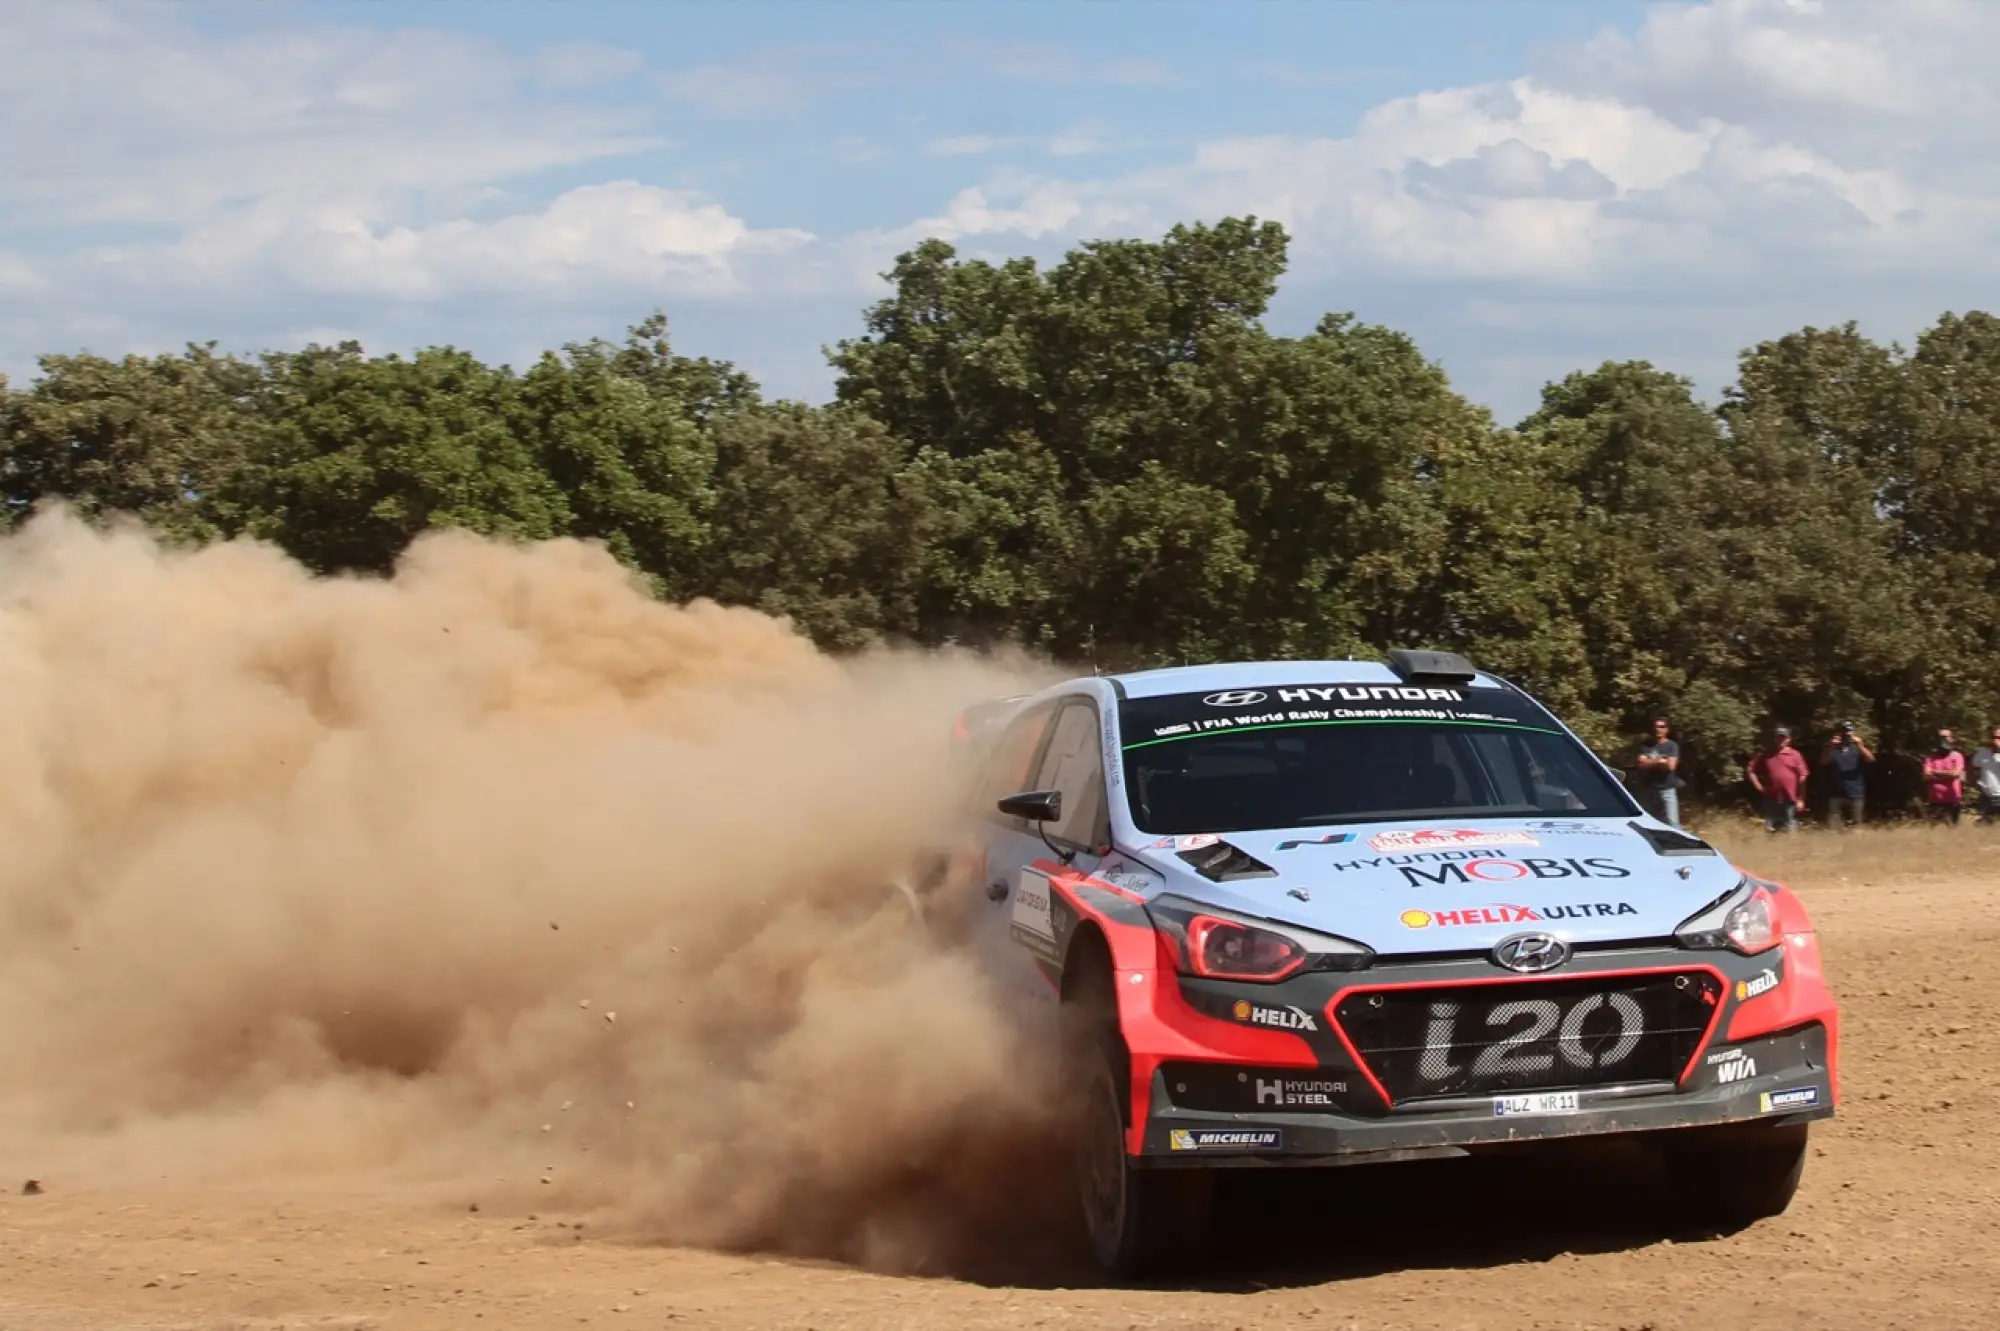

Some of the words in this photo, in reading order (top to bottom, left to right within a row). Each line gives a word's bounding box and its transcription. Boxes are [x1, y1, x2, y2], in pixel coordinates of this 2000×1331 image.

[1278, 687, 1463, 702] HYUNDAI
[1203, 718, 1234, 729] FIA
[1235, 711, 1284, 724] World
[1288, 710, 1329, 721] Rally
[1333, 708, 1448, 720] Championship
[1333, 850, 1506, 871] HYUNDAI
[1398, 858, 1631, 887] MOBIS
[1434, 903, 1543, 927] HELIX
[1542, 902, 1638, 920] ULTRA
[1747, 968, 1778, 997] HELIX
[1252, 1005, 1318, 1031] HELIX
[1418, 992, 1644, 1081] i20
[1285, 1081, 1347, 1093] HYUNDAI
[1286, 1094, 1332, 1104] STEEL
[1504, 1099, 1531, 1113] ALZ
[1199, 1133, 1276, 1144] MICHELIN
